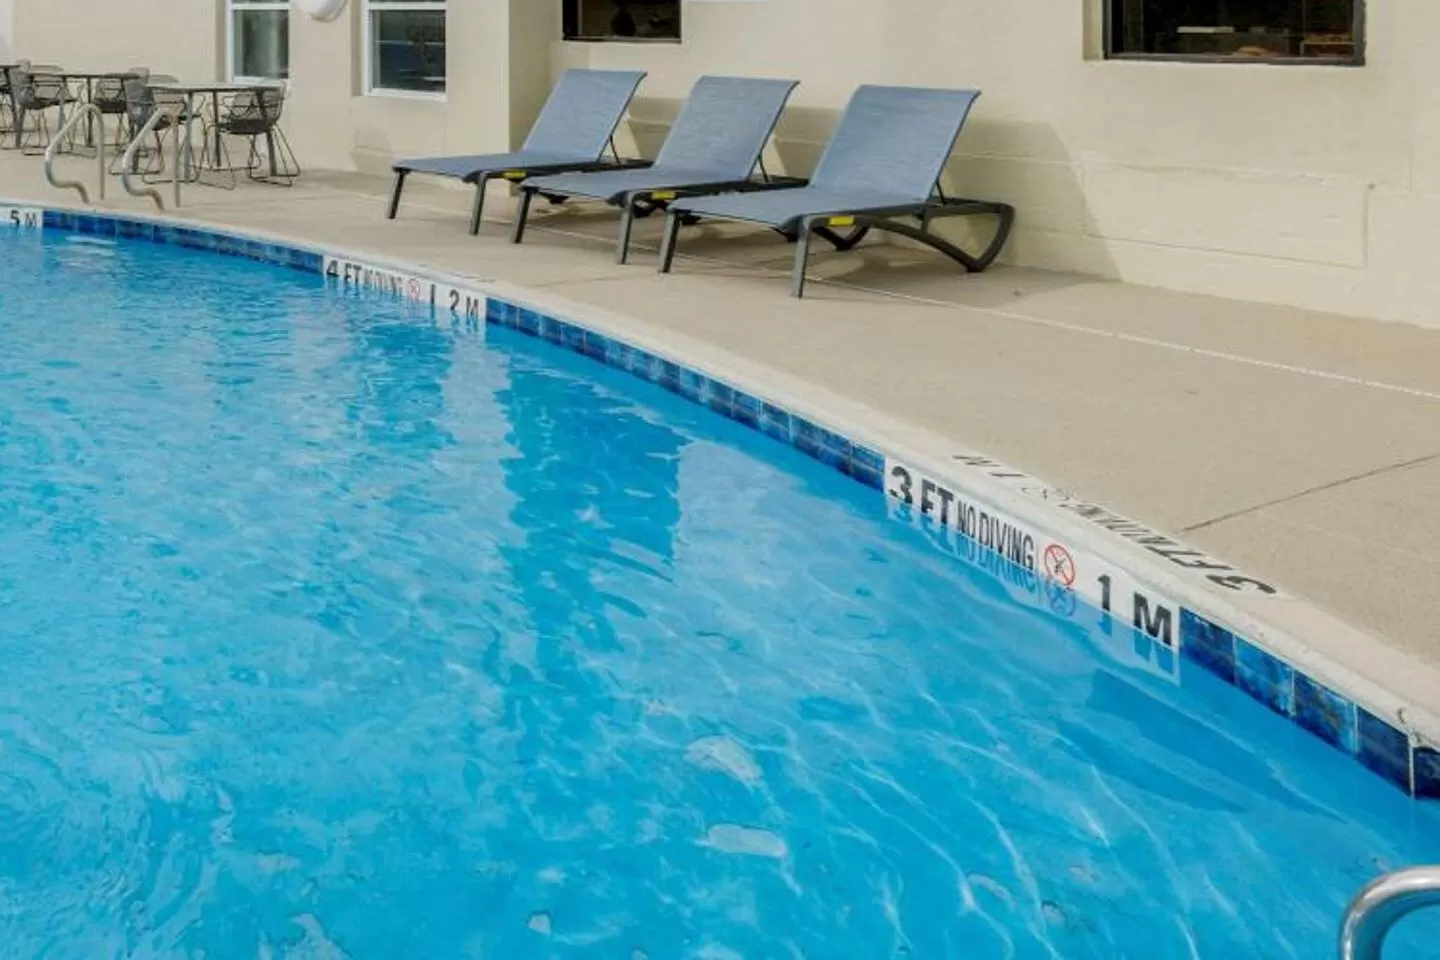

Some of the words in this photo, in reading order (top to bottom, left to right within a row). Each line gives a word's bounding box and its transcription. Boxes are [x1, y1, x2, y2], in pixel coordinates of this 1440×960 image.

[326, 259, 339, 278] 4
[344, 262, 362, 286] FT
[889, 466, 913, 505] 3
[921, 478, 955, 526] FT
[957, 500, 976, 539] NO
[978, 511, 1035, 572] DIVING
[1097, 574, 1112, 614] 1
[1133, 591, 1173, 646] M
